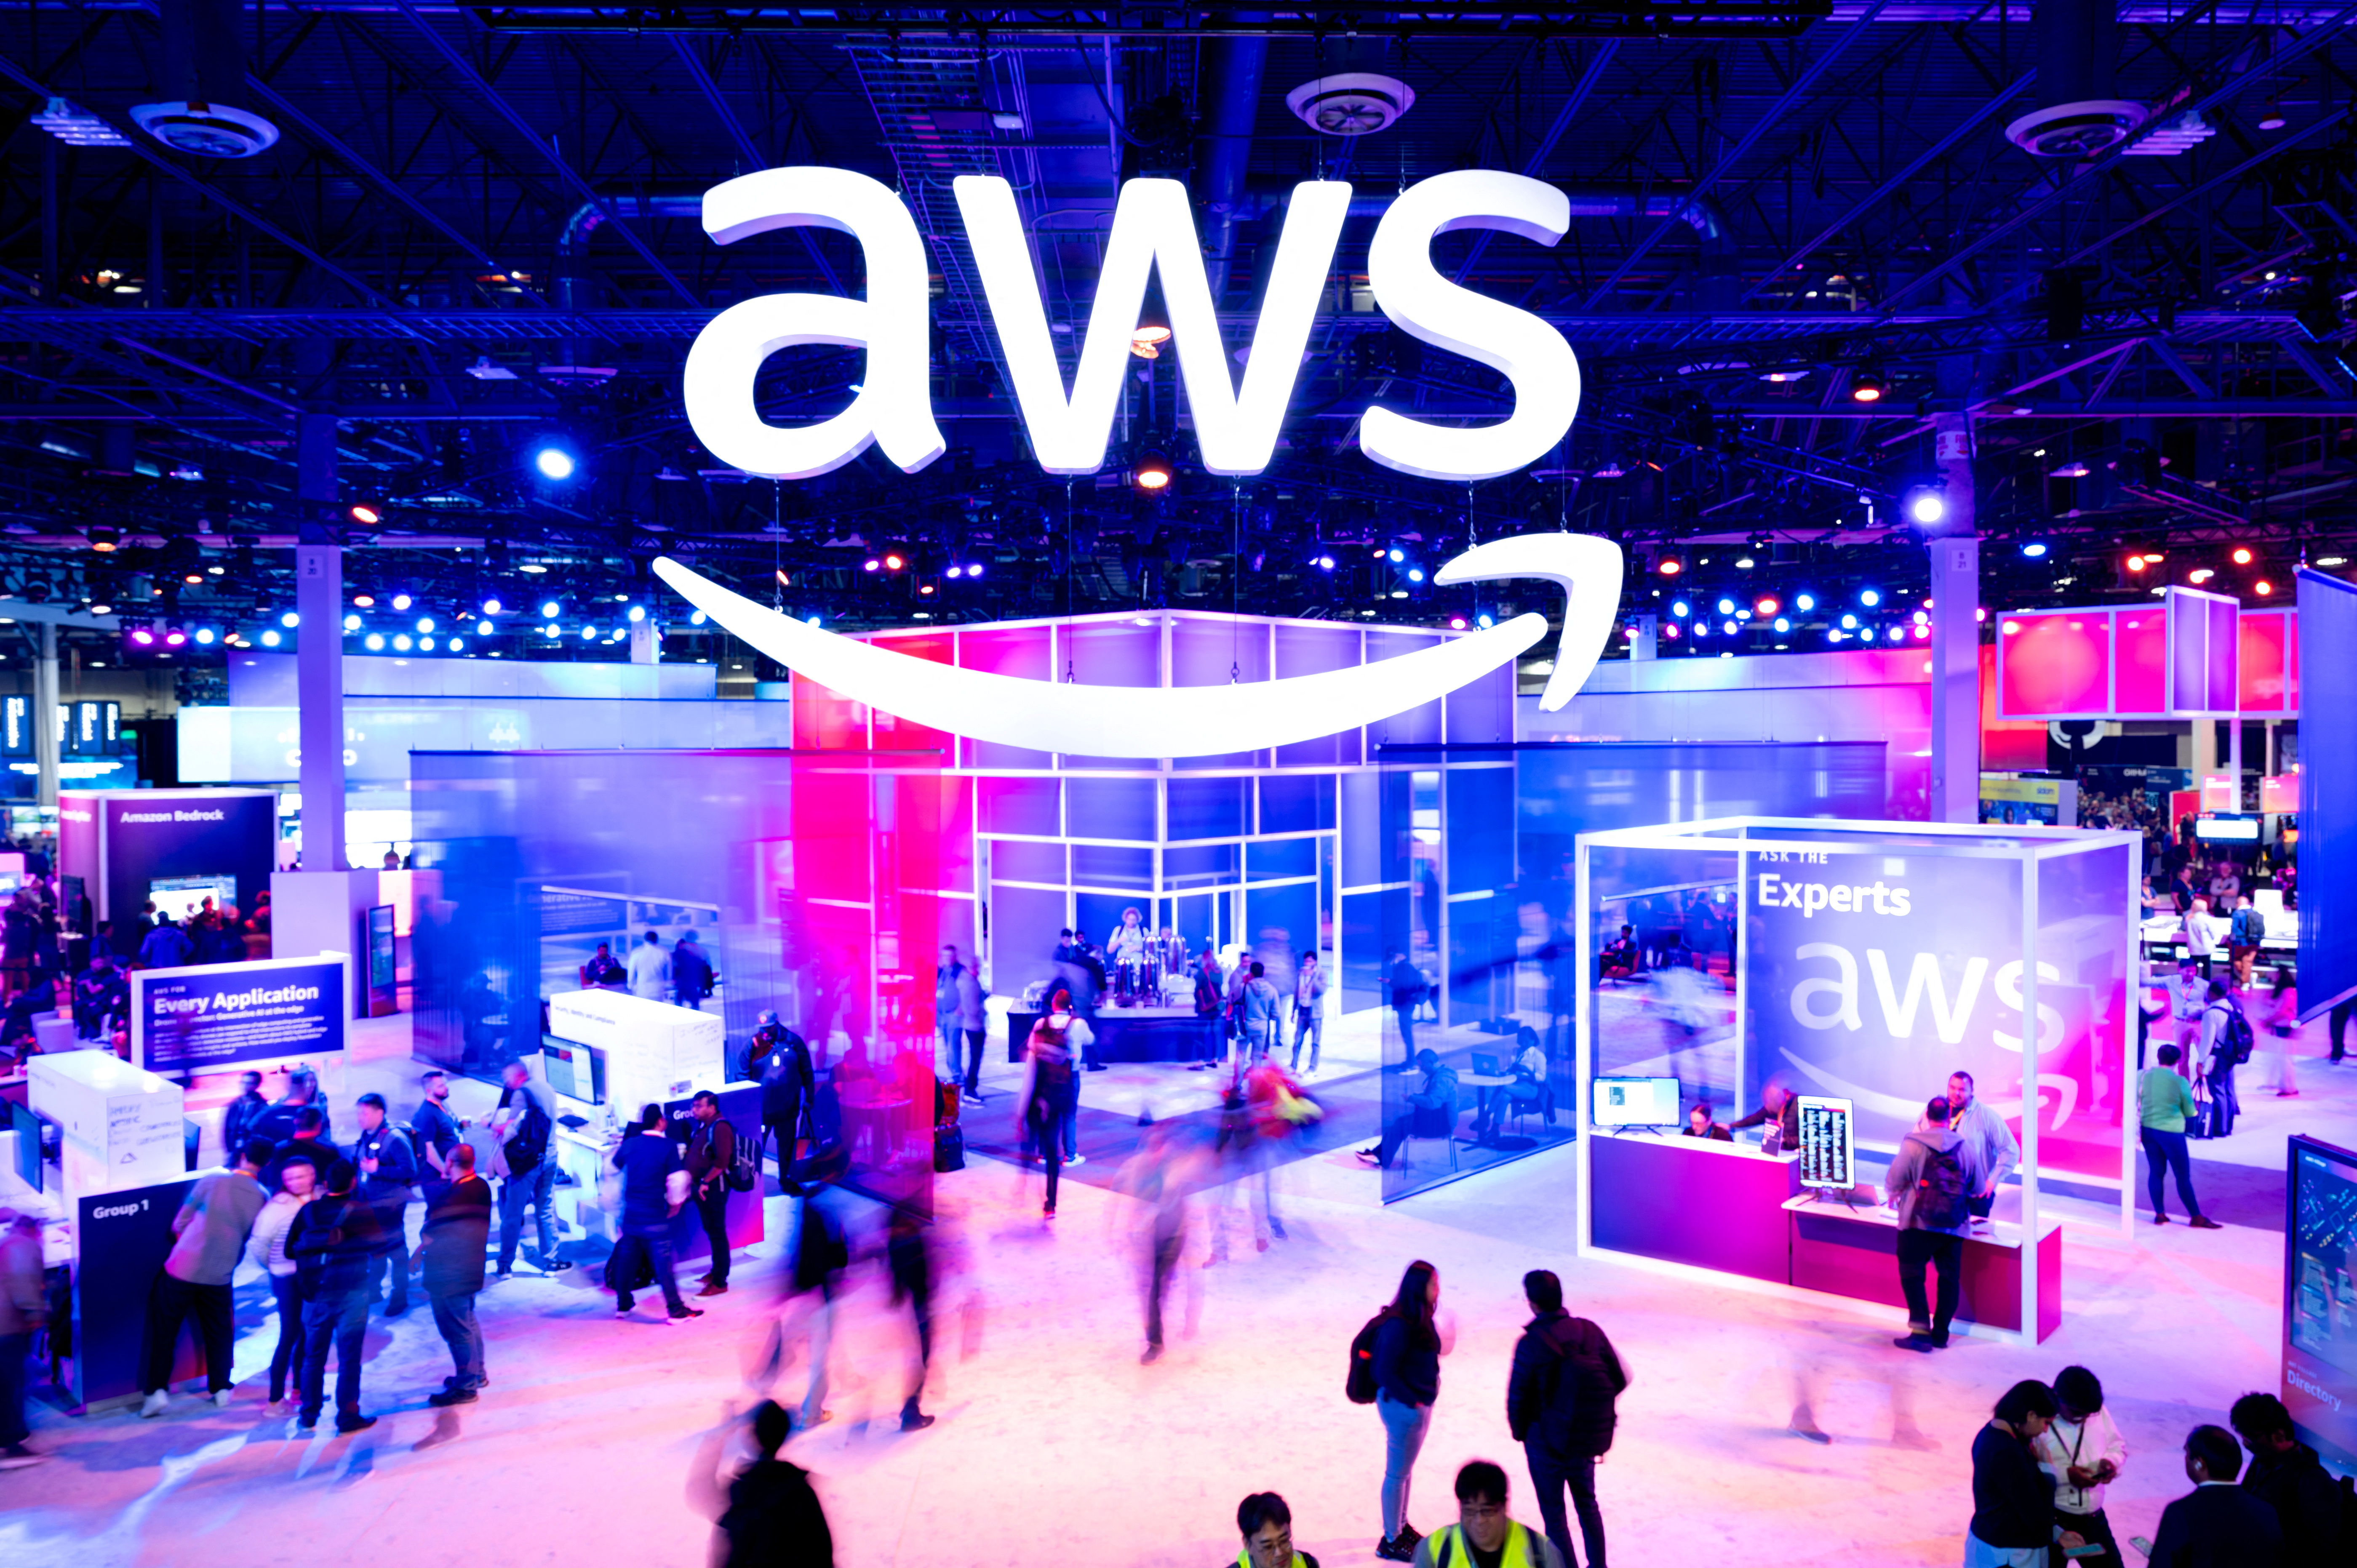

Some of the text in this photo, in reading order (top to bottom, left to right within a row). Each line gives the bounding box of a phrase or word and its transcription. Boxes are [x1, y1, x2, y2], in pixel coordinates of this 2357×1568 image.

[683, 166, 1581, 480] aws
[2123, 768, 2147, 777] GitHu
[120, 809, 224, 823] Amazon Bedrock
[1759, 851, 1828, 864] ASK THE
[1758, 872, 1911, 918] Experts
[154, 984, 319, 1014] Every Application
[1790, 942, 2065, 1054] aws
[216, 1010, 256, 1020] Generative
[265, 1008, 273, 1016] at
[273, 1006, 286, 1015] the
[286, 1005, 304, 1014] edge
[92, 1199, 149, 1219] Group 1
[2287, 1368, 2341, 1412] Directory
